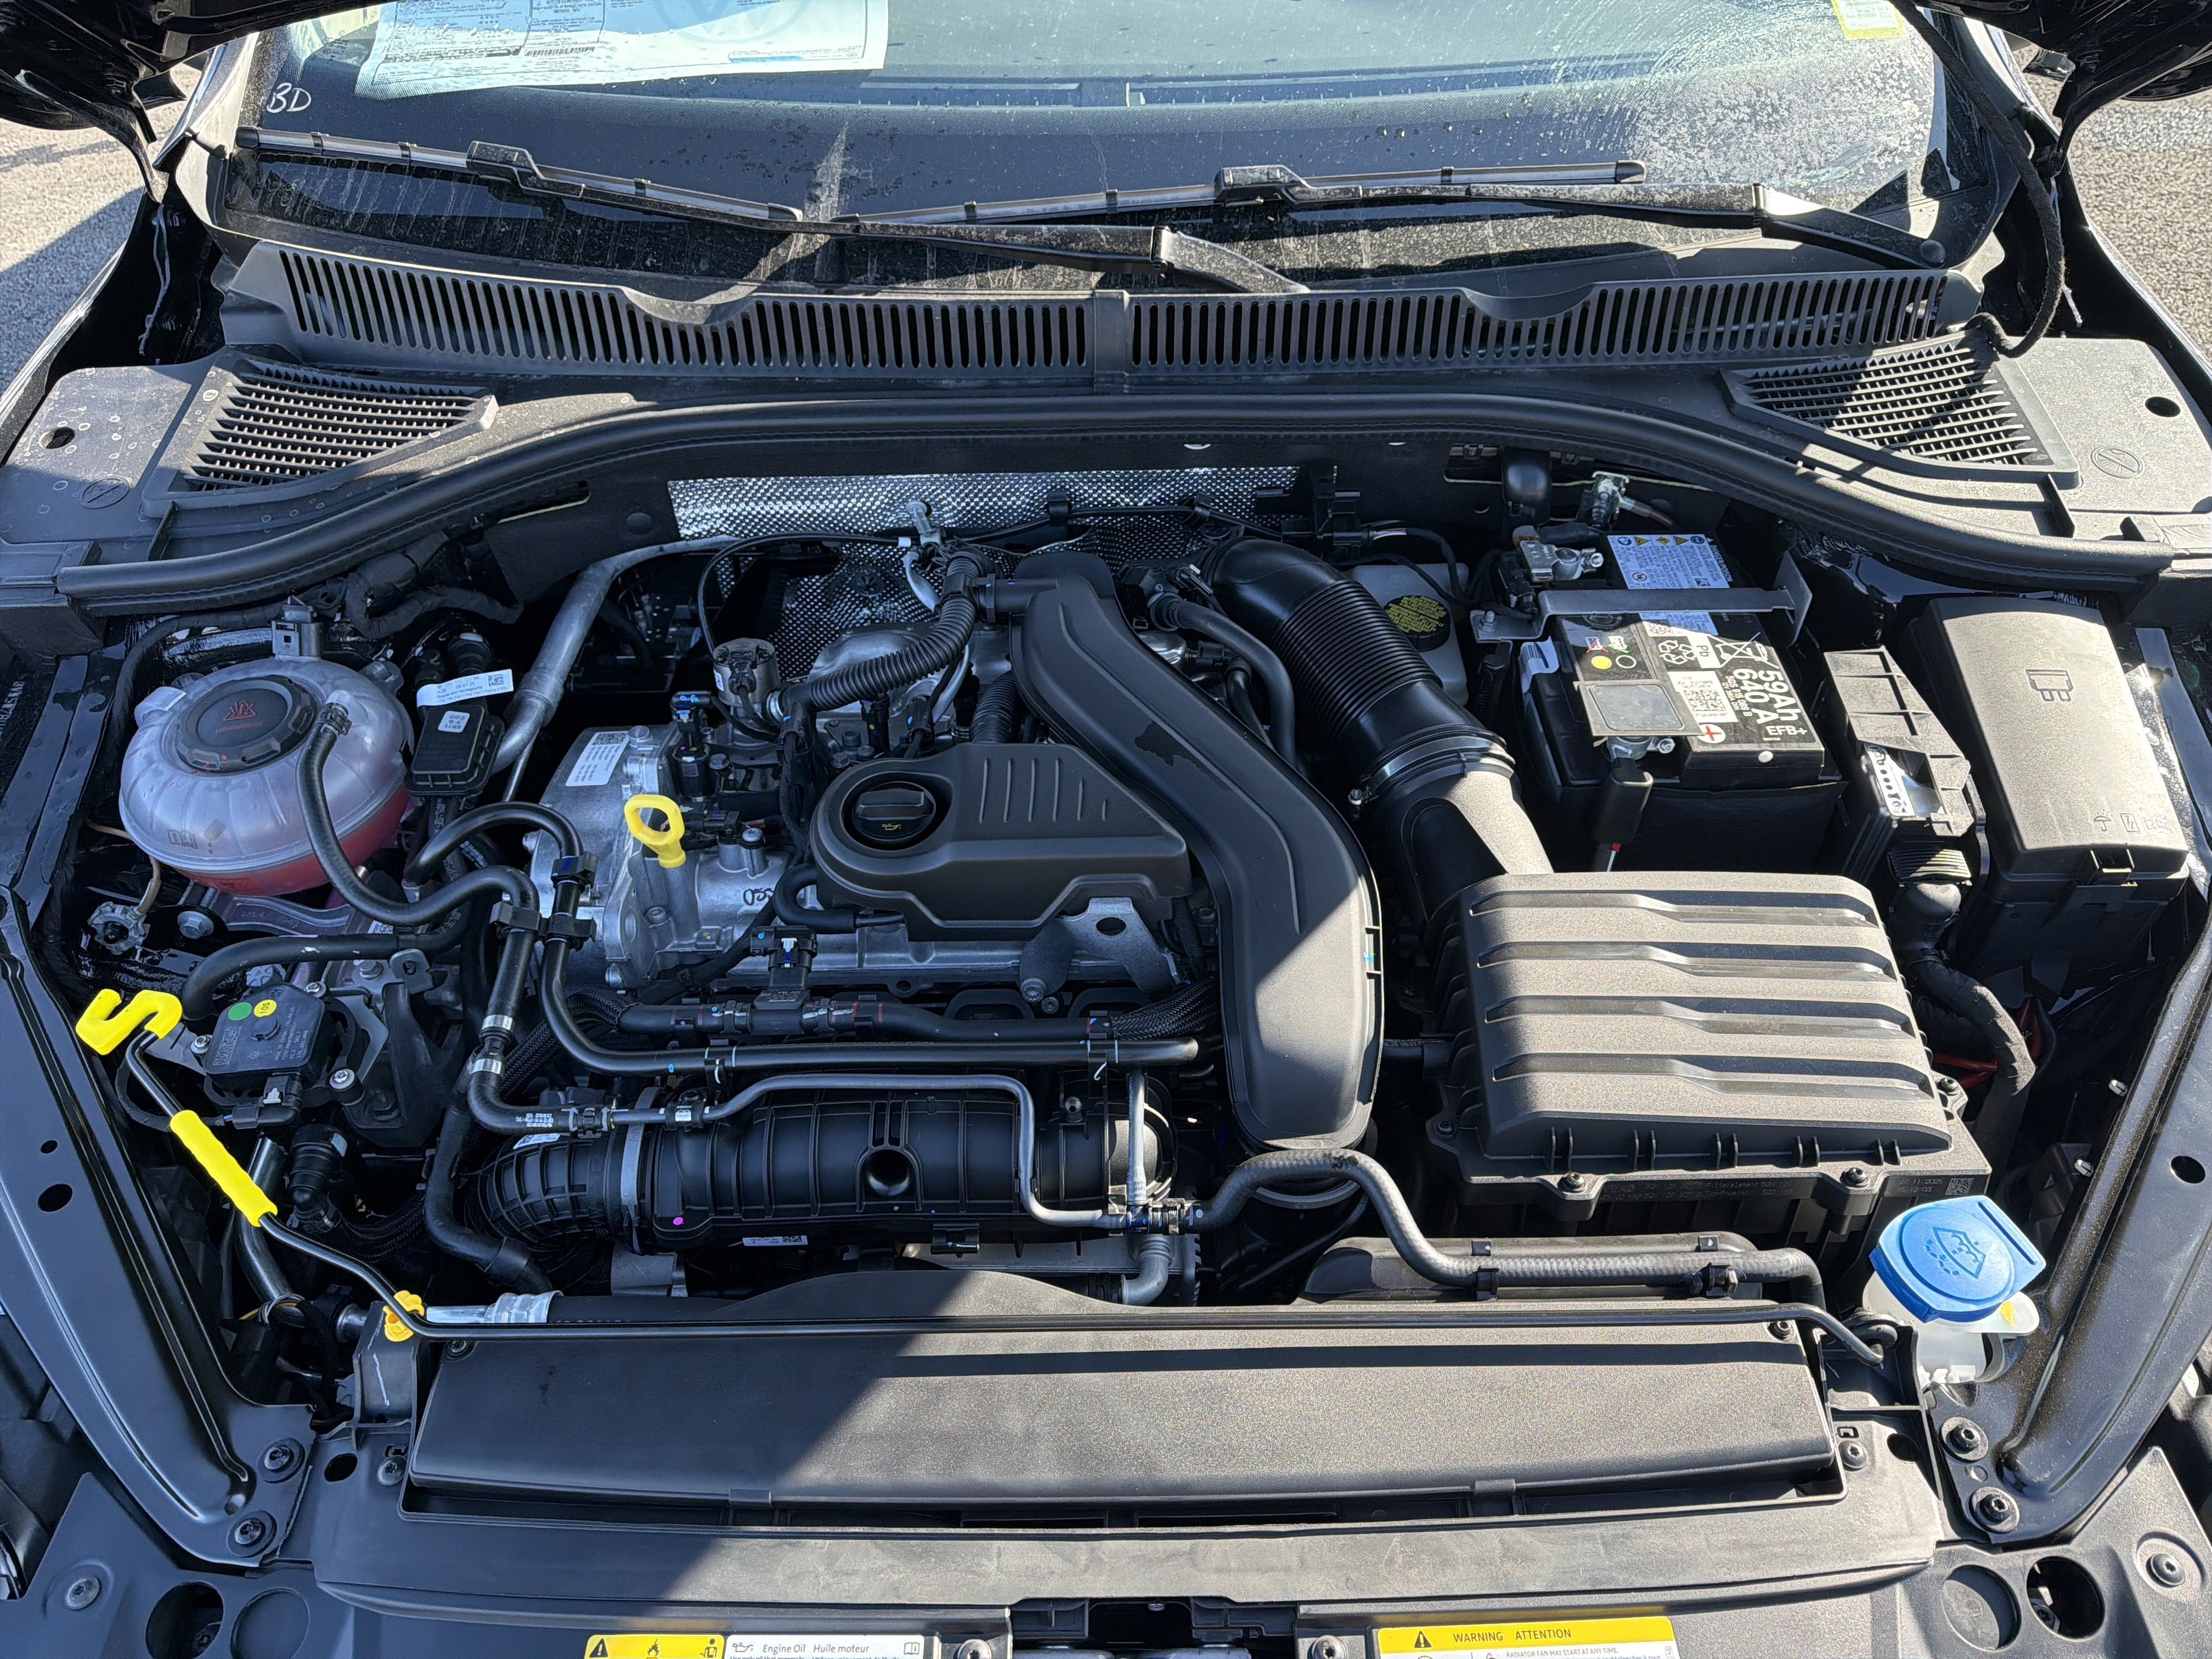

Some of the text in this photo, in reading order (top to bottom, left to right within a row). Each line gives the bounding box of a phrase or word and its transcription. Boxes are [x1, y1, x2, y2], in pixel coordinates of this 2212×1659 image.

[1696, 644, 1711, 658] Pb
[1733, 668, 1770, 703] 640
[1758, 669, 1801, 721] 59Ah
[1751, 708, 1780, 725] A
[1765, 725, 1808, 736] EFB+
[1452, 1628, 1572, 1644] WARNING ATTENTION
[763, 1644, 870, 1654] Engine Oil Huile moteur
